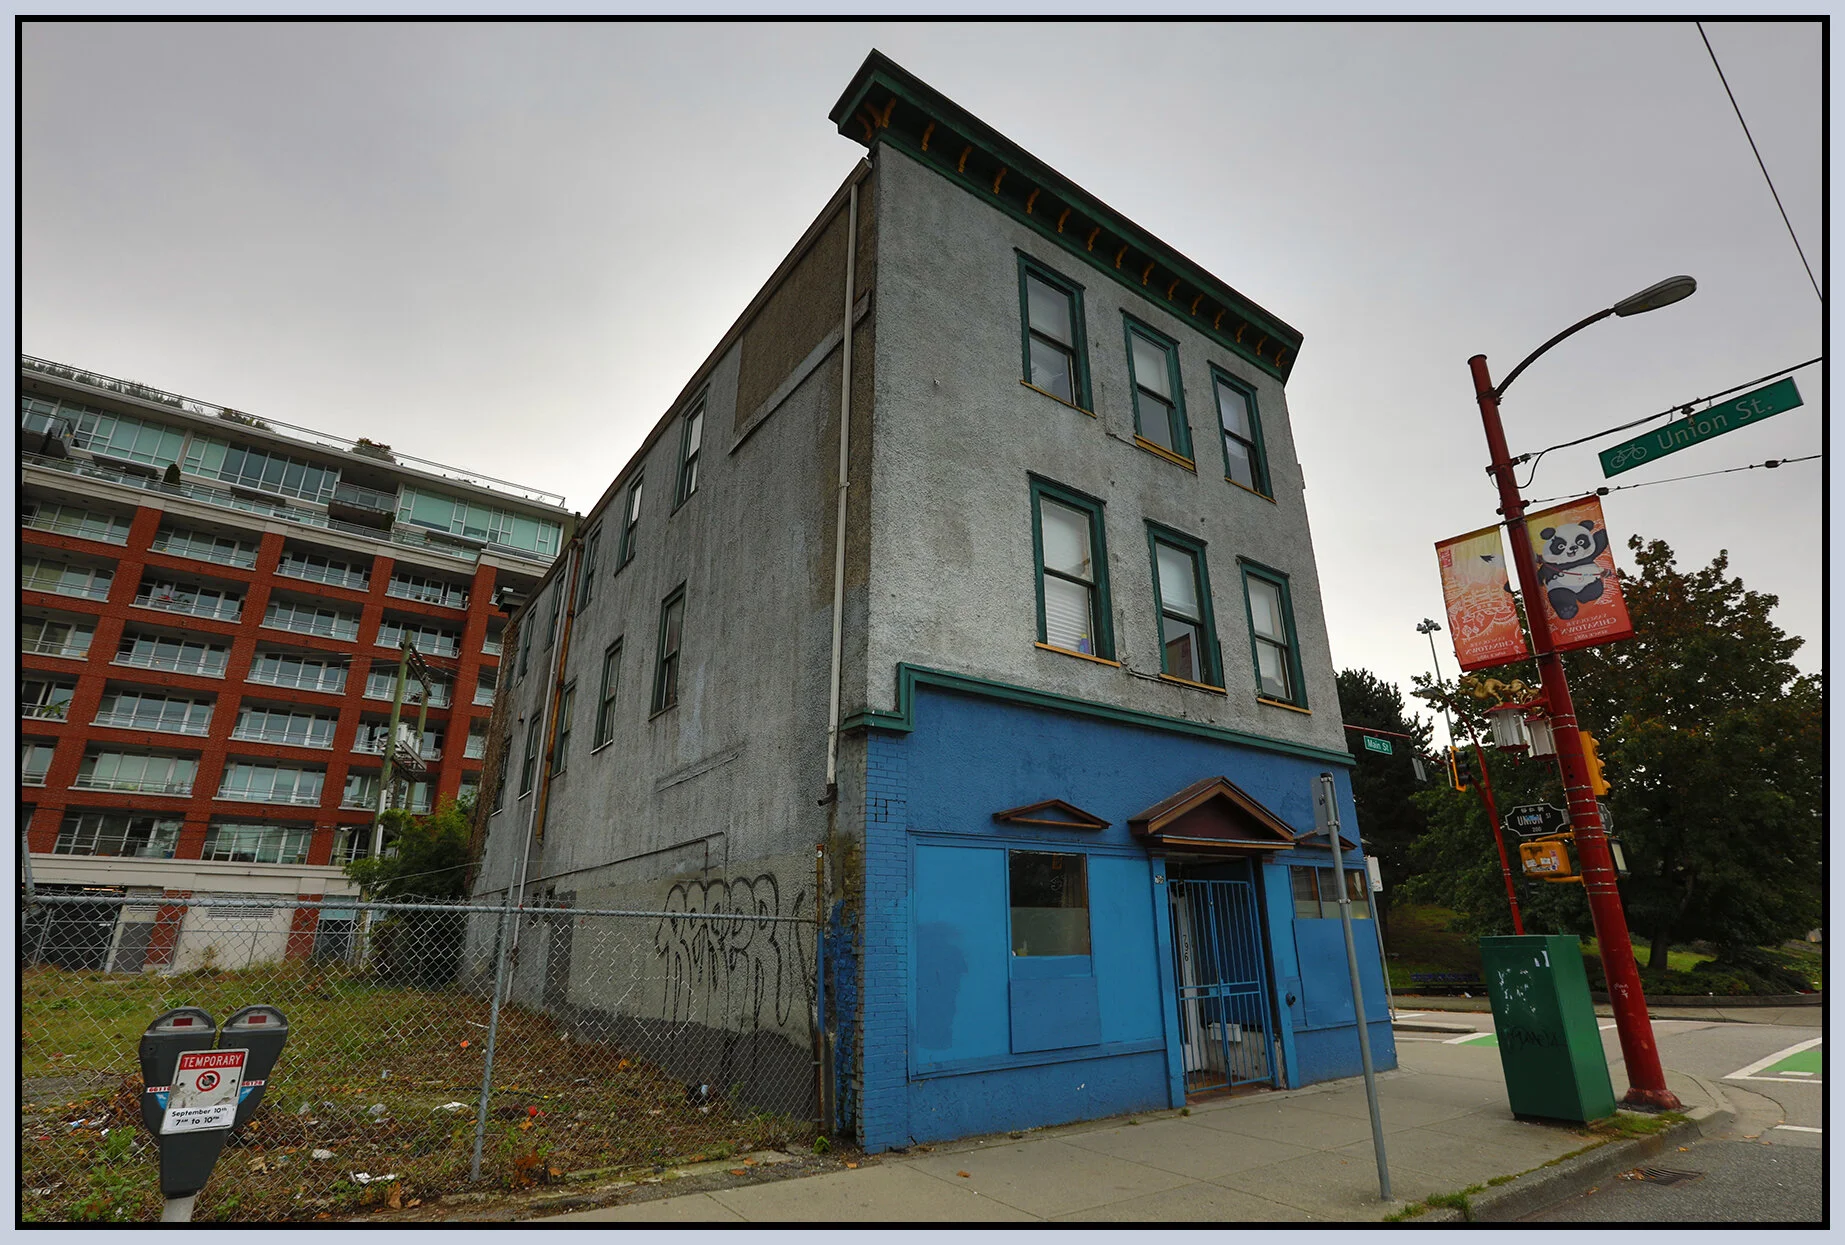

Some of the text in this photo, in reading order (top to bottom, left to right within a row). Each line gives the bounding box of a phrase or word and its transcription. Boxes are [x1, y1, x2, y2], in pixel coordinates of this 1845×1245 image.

[1657, 398, 1773, 450] Union St.
[1367, 739, 1382, 750] Main
[183, 1054, 242, 1068] TEMPORARY
[172, 1109, 211, 1117] September
